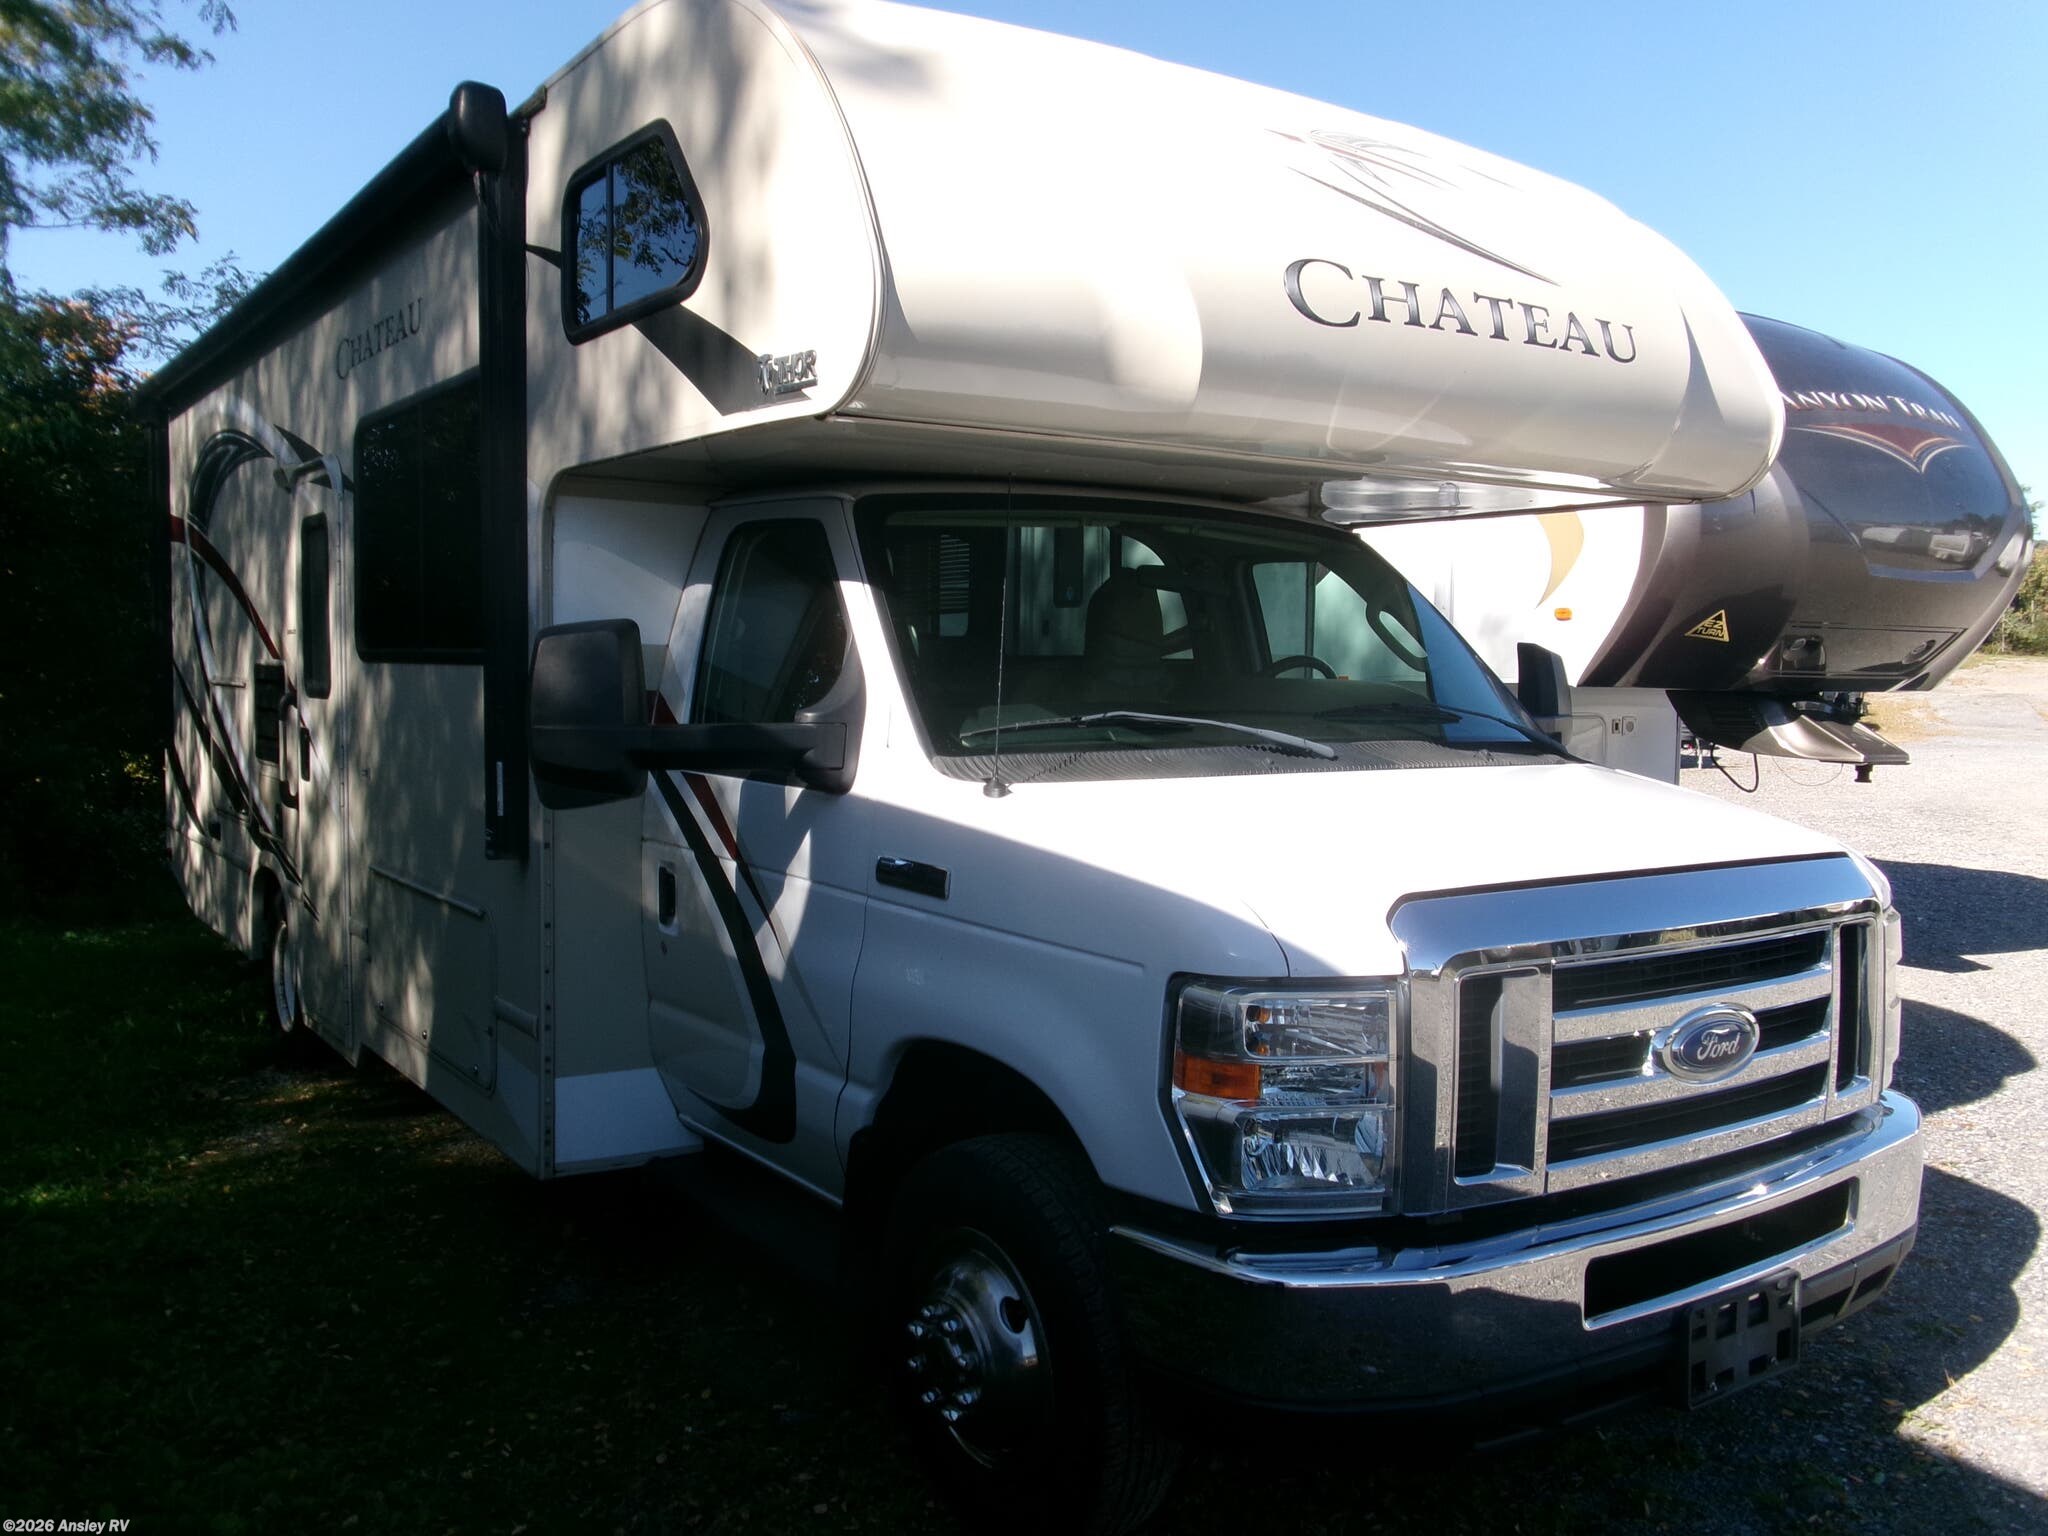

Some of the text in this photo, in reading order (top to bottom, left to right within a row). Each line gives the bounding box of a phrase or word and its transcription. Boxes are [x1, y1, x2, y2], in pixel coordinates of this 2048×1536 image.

[336, 297, 423, 380] CHATEAU
[1284, 258, 1637, 363] CHATEAU
[1696, 627, 1724, 637] TURN
[1697, 1023, 1741, 1061] Ford
